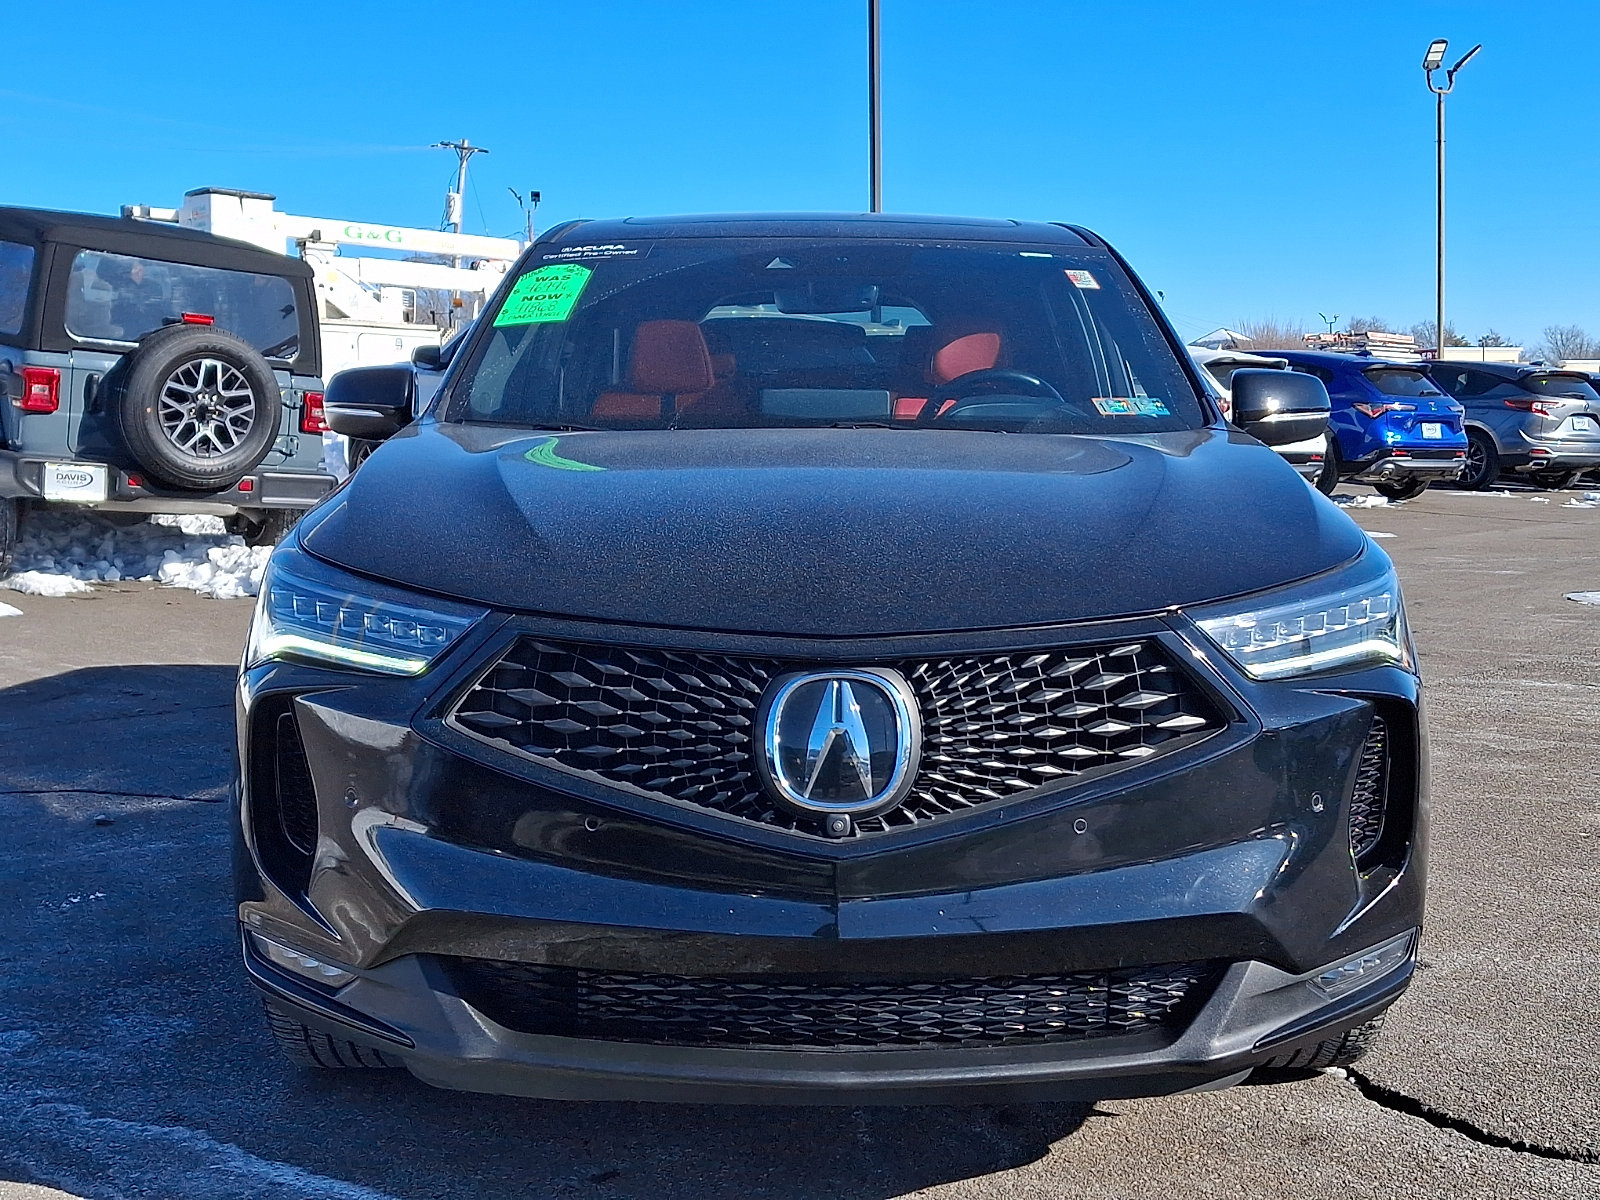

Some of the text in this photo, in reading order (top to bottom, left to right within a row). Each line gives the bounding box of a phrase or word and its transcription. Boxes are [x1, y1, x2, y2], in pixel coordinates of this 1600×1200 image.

[572, 244, 625, 252] ACURA
[542, 249, 638, 260] Certified Pre-Owned
[521, 293, 563, 302] NOW
[56, 473, 87, 481] DAVIS
